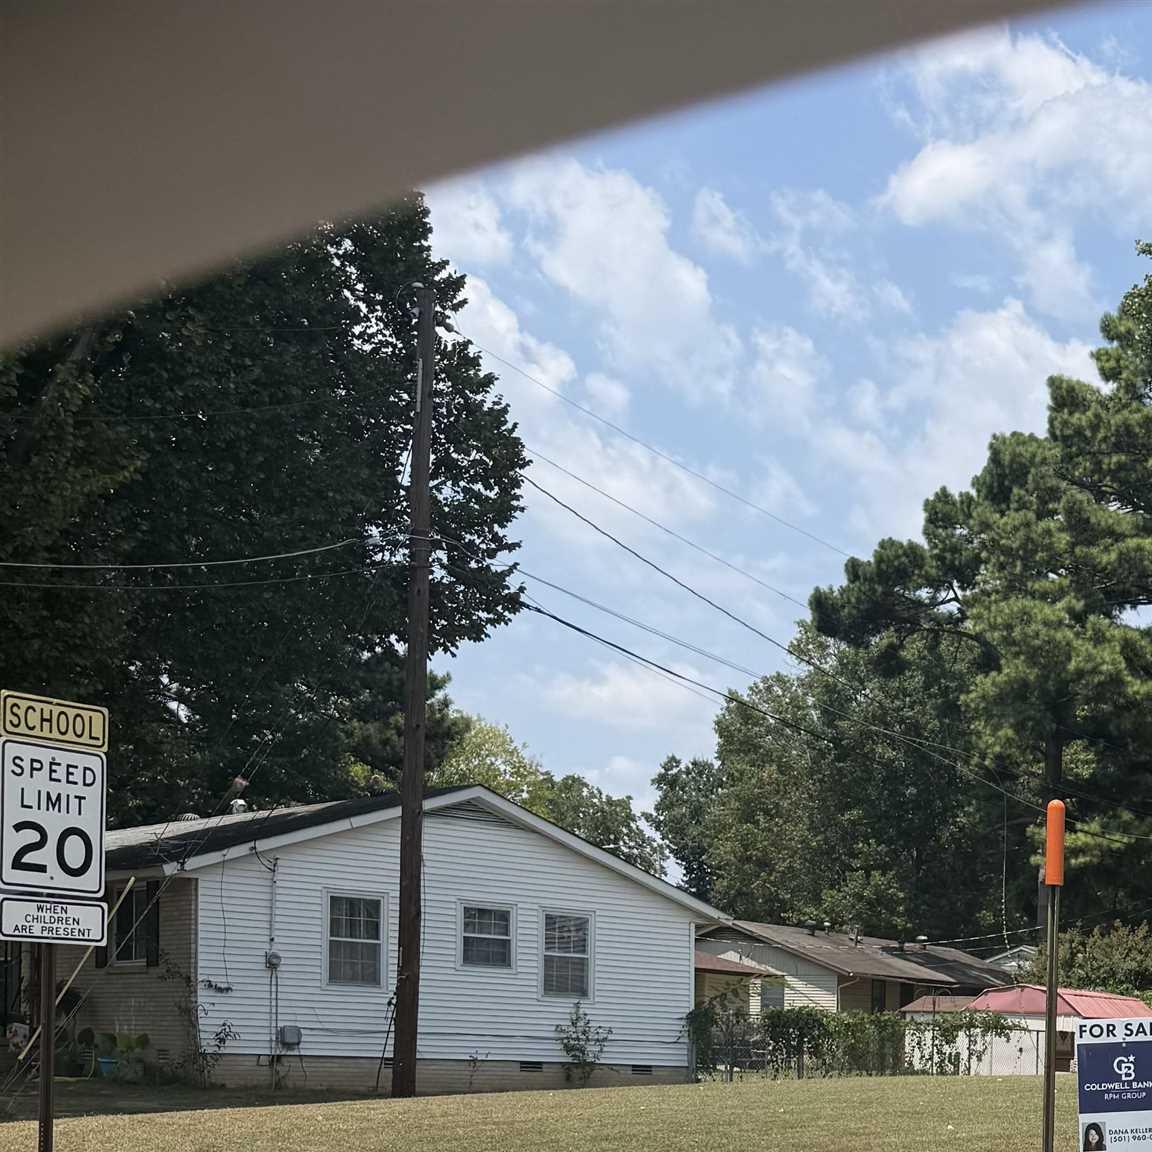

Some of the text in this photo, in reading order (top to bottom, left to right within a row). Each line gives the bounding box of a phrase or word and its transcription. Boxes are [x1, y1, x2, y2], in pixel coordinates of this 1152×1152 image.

[9, 703, 100, 741] SCHOOL
[11, 756, 96, 787] SPEED
[21, 787, 86, 816] LIMIT
[11, 820, 93, 877] 20
[36, 904, 68, 915] WHEN
[25, 914, 80, 926] CHILDREN
[13, 924, 92, 938] ARE PRESENT
[1079, 1023, 1117, 1039] FOR
[1084, 1082, 1130, 1091] COLDWELL
[1121, 1091, 1146, 1099] GROUP
[1108, 1128, 1129, 1136] DANA
[1110, 1135, 1130, 1143] (501)
